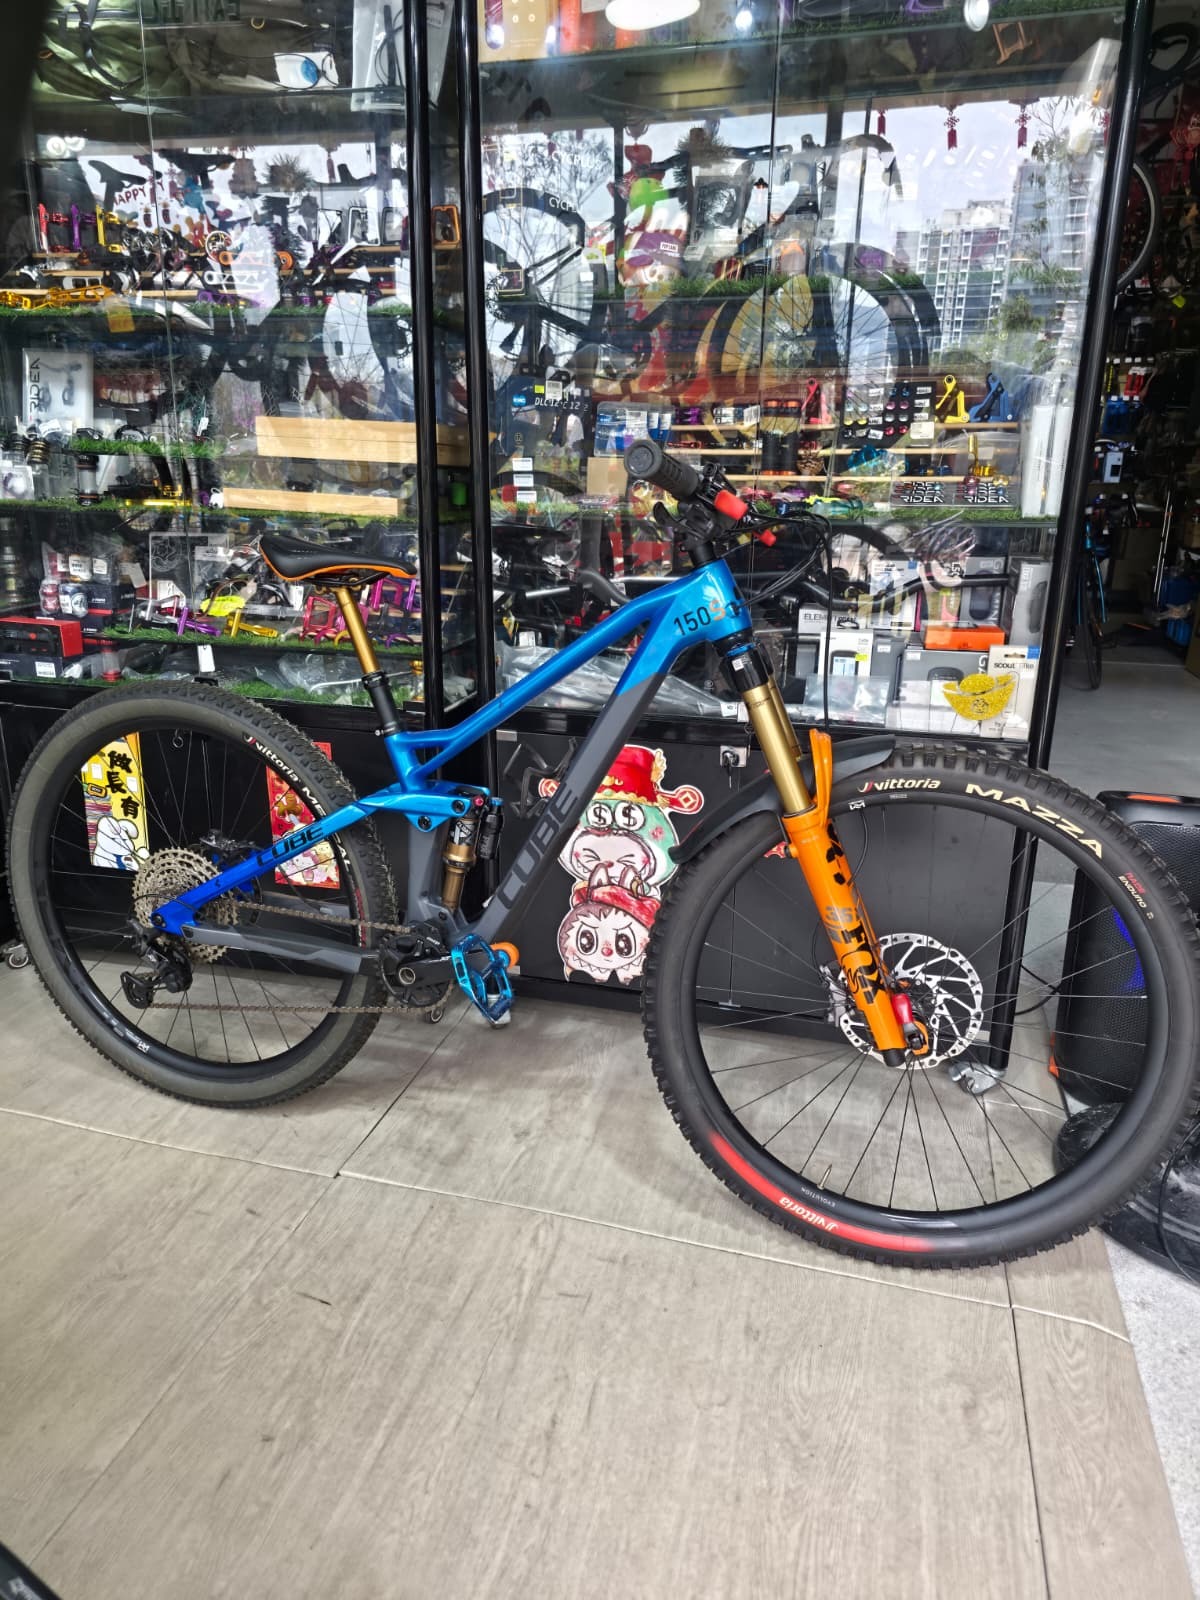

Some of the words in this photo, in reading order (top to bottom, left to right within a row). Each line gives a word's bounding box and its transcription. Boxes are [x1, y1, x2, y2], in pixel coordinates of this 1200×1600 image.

[29, 358, 41, 413] RIDEA
[900, 495, 944, 503] RIDEA
[964, 495, 1009, 503] RIDEA
[673, 599, 726, 636] 150S
[255, 742, 299, 782] vittoria
[873, 778, 941, 791] vittoria
[965, 783, 1103, 860] MAZZA
[256, 827, 324, 867] CUBE
[497, 782, 578, 910] CUBE
[1118, 875, 1148, 909] ENDURO
[779, 1196, 826, 1228] vittoria
